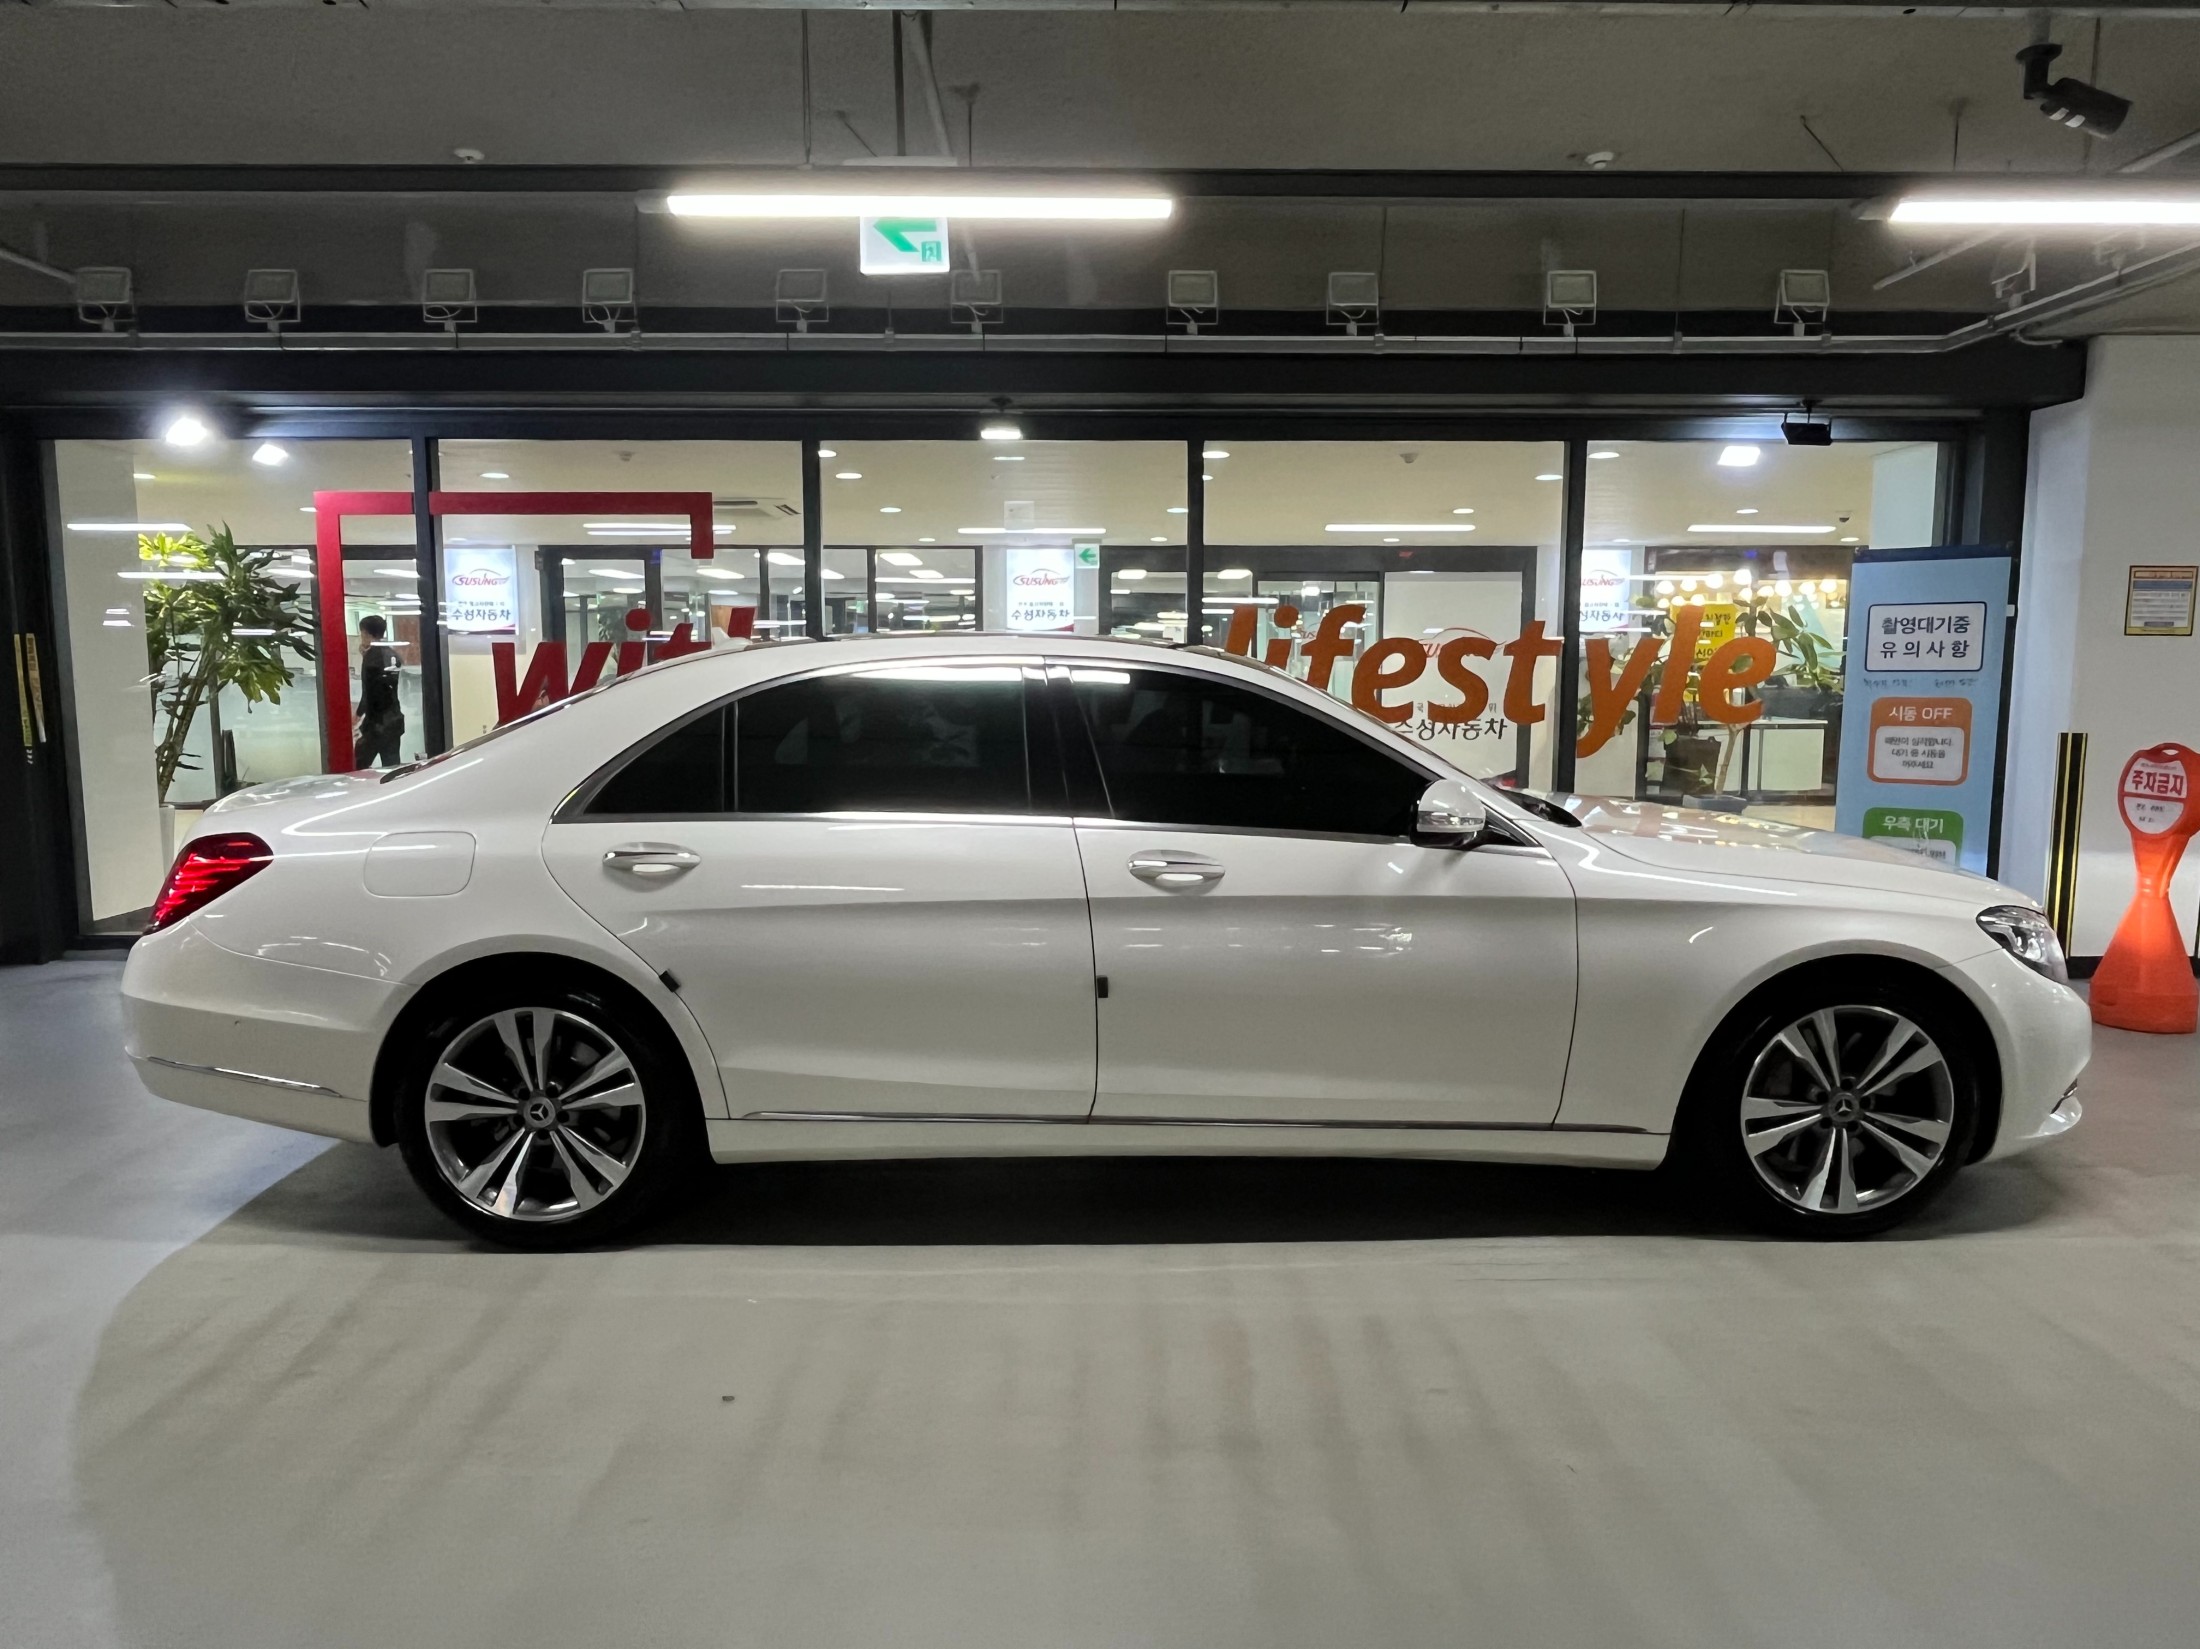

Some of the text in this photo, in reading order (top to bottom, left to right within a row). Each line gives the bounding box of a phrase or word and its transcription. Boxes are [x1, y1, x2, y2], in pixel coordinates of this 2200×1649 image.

[451, 608, 512, 621] 수성자동차
[1011, 608, 1071, 621] 수성자동차
[1579, 609, 1625, 622] 성자동차
[1881, 615, 1971, 635] 촬영대기중
[1889, 706, 1953, 721] 시동 OFF
[1882, 815, 1944, 834] 우측 대기
